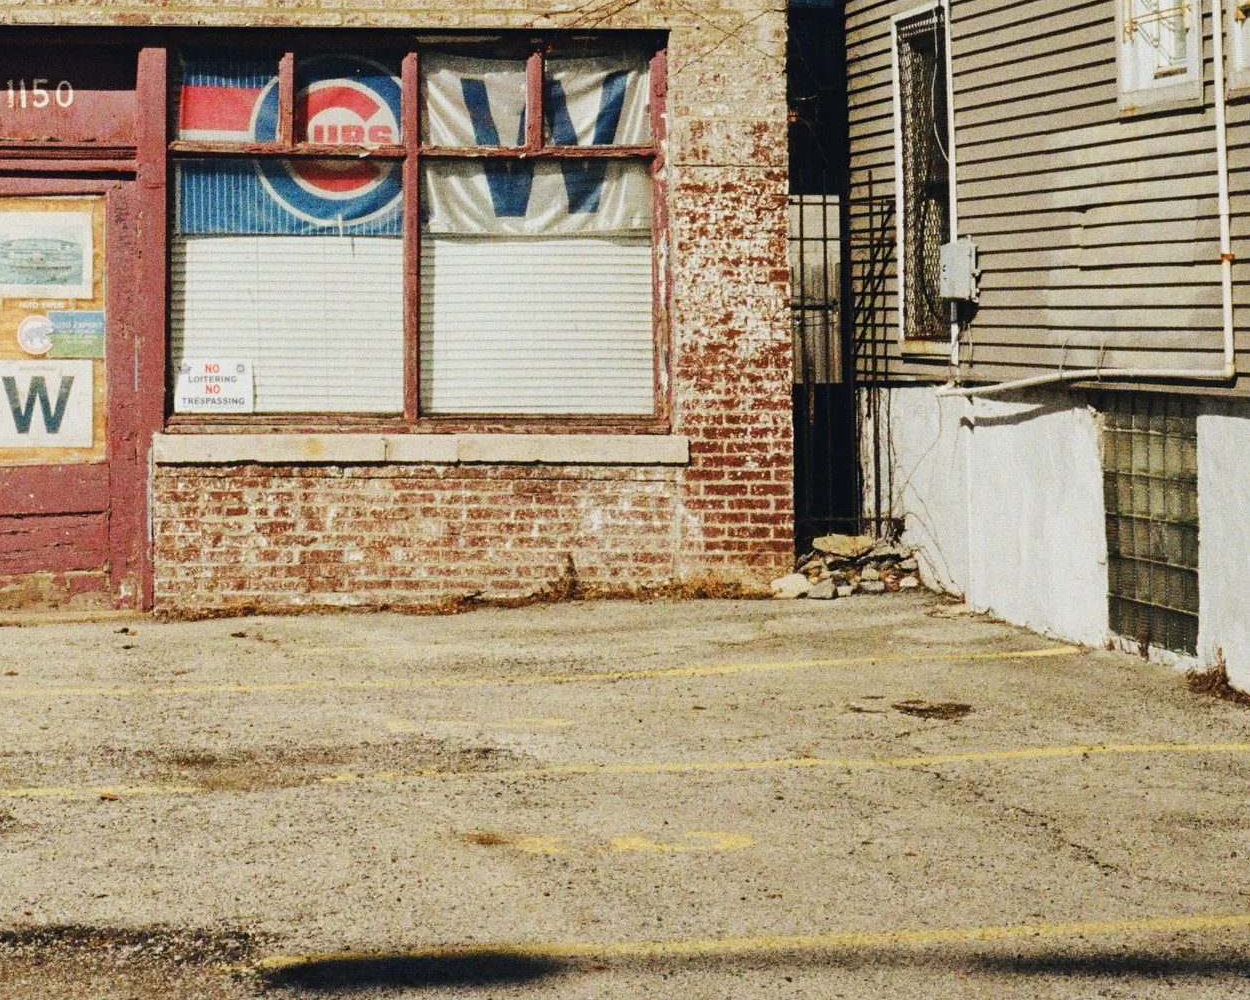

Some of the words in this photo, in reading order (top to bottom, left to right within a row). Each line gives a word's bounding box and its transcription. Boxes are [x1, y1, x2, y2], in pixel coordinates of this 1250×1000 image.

[6, 79, 75, 109] 1150
[460, 70, 629, 217] W
[204, 363, 220, 374] NO
[188, 375, 238, 383] LOITERING
[205, 384, 221, 394] NO
[1, 375, 75, 435] W
[181, 397, 245, 405] TRESPASSING
